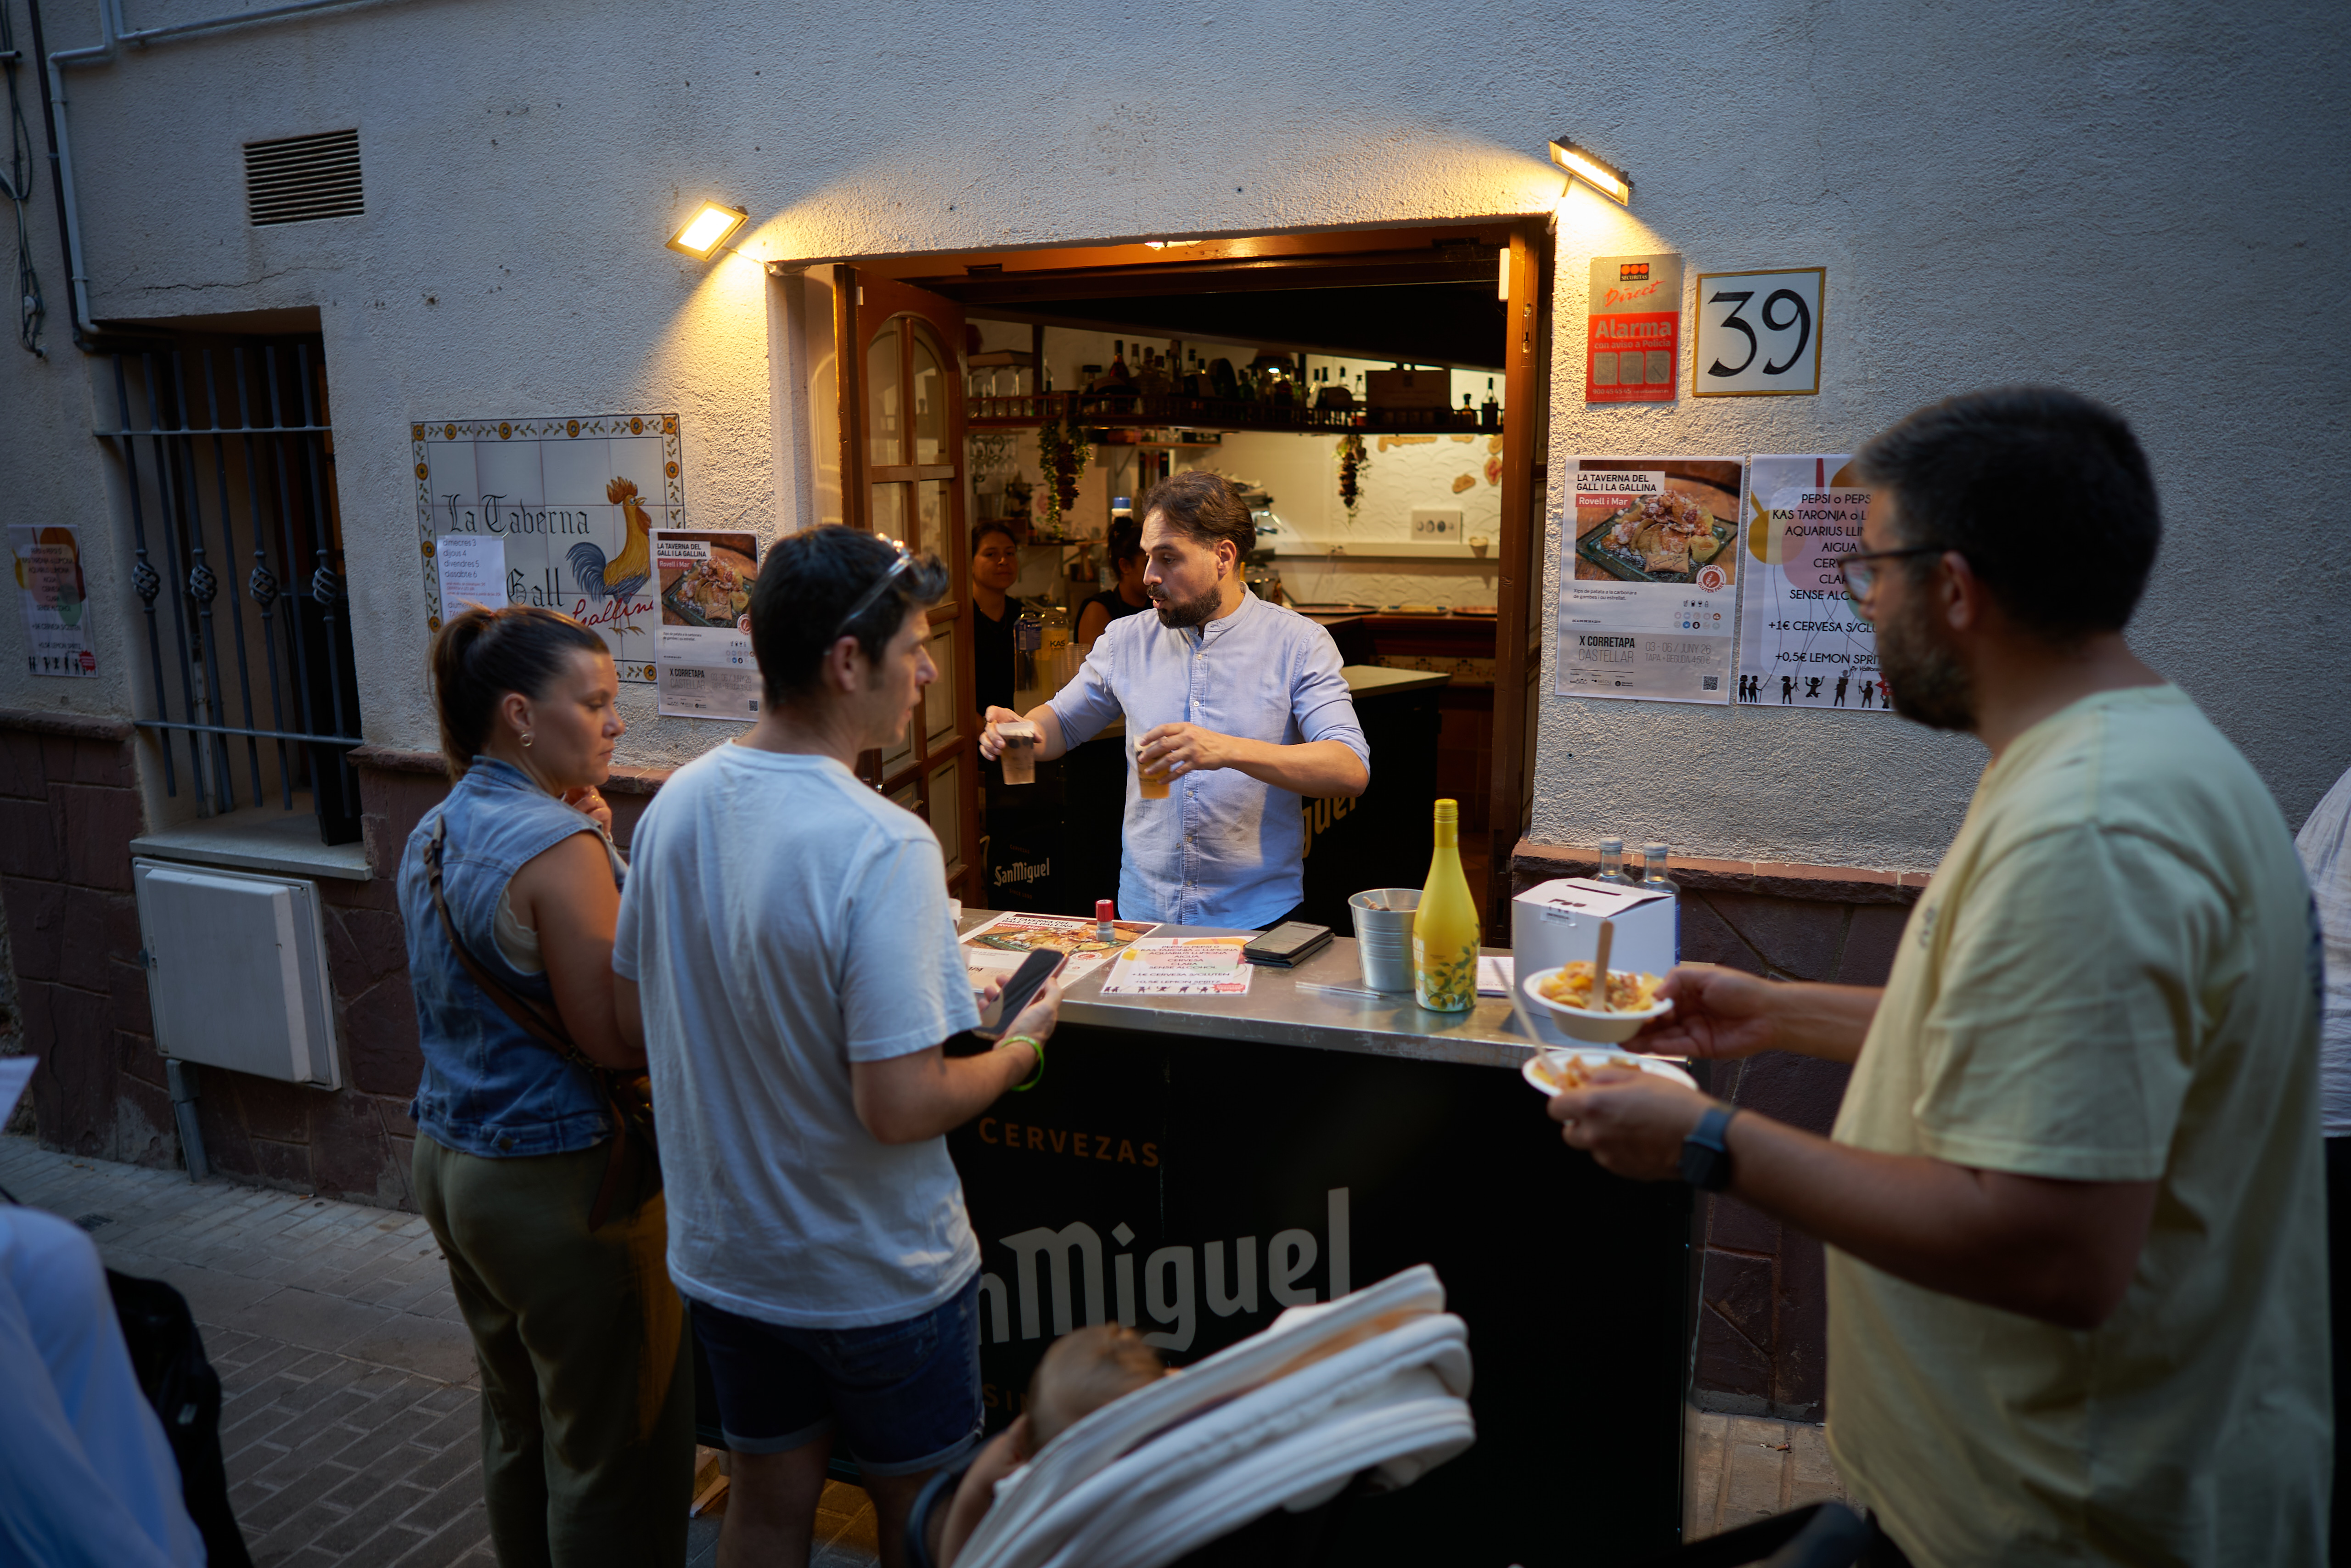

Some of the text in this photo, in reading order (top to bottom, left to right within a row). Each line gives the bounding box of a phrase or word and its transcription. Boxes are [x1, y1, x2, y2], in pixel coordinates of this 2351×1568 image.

[1604, 280, 1666, 307] Direct
[1595, 319, 1671, 338] Alarma
[1708, 288, 1811, 377] 39
[1611, 340, 1633, 348] aviso
[1801, 494, 1831, 504] PEPSI
[441, 493, 591, 535] La Taberna
[1772, 510, 1794, 520] KAS
[1798, 510, 1847, 522] TARONJA
[1785, 526, 1843, 537] AQUARIUS
[1821, 542, 1857, 552] AIGUA
[443, 550, 461, 558] dijous
[506, 567, 564, 607] Gall
[1698, 581, 1714, 593] GLUTEN
[1789, 589, 1824, 600] SENSE
[1768, 620, 1878, 633] +1€ CERVESA S/GLU
[1580, 635, 1635, 648] X CORRETAPA
[1645, 641, 1655, 651] 03
[1662, 642, 1672, 652] 06
[1681, 643, 1699, 653] JUNY
[1701, 644, 1711, 654] 26
[1579, 648, 1634, 663] CASTELLAR
[1645, 653, 1661, 662] TAPA
[1667, 654, 1689, 663] BEGUDA
[1706, 656, 1711, 664] €
[1775, 652, 1807, 663] +0,5€
[1810, 652, 1850, 664] LEMON
[669, 669, 705, 679] X CORRETAPA
[670, 678, 706, 690] CASTELLAR
[979, 1116, 1160, 1168] CERVEZAS
[978, 1186, 1351, 1352] nMiguel
